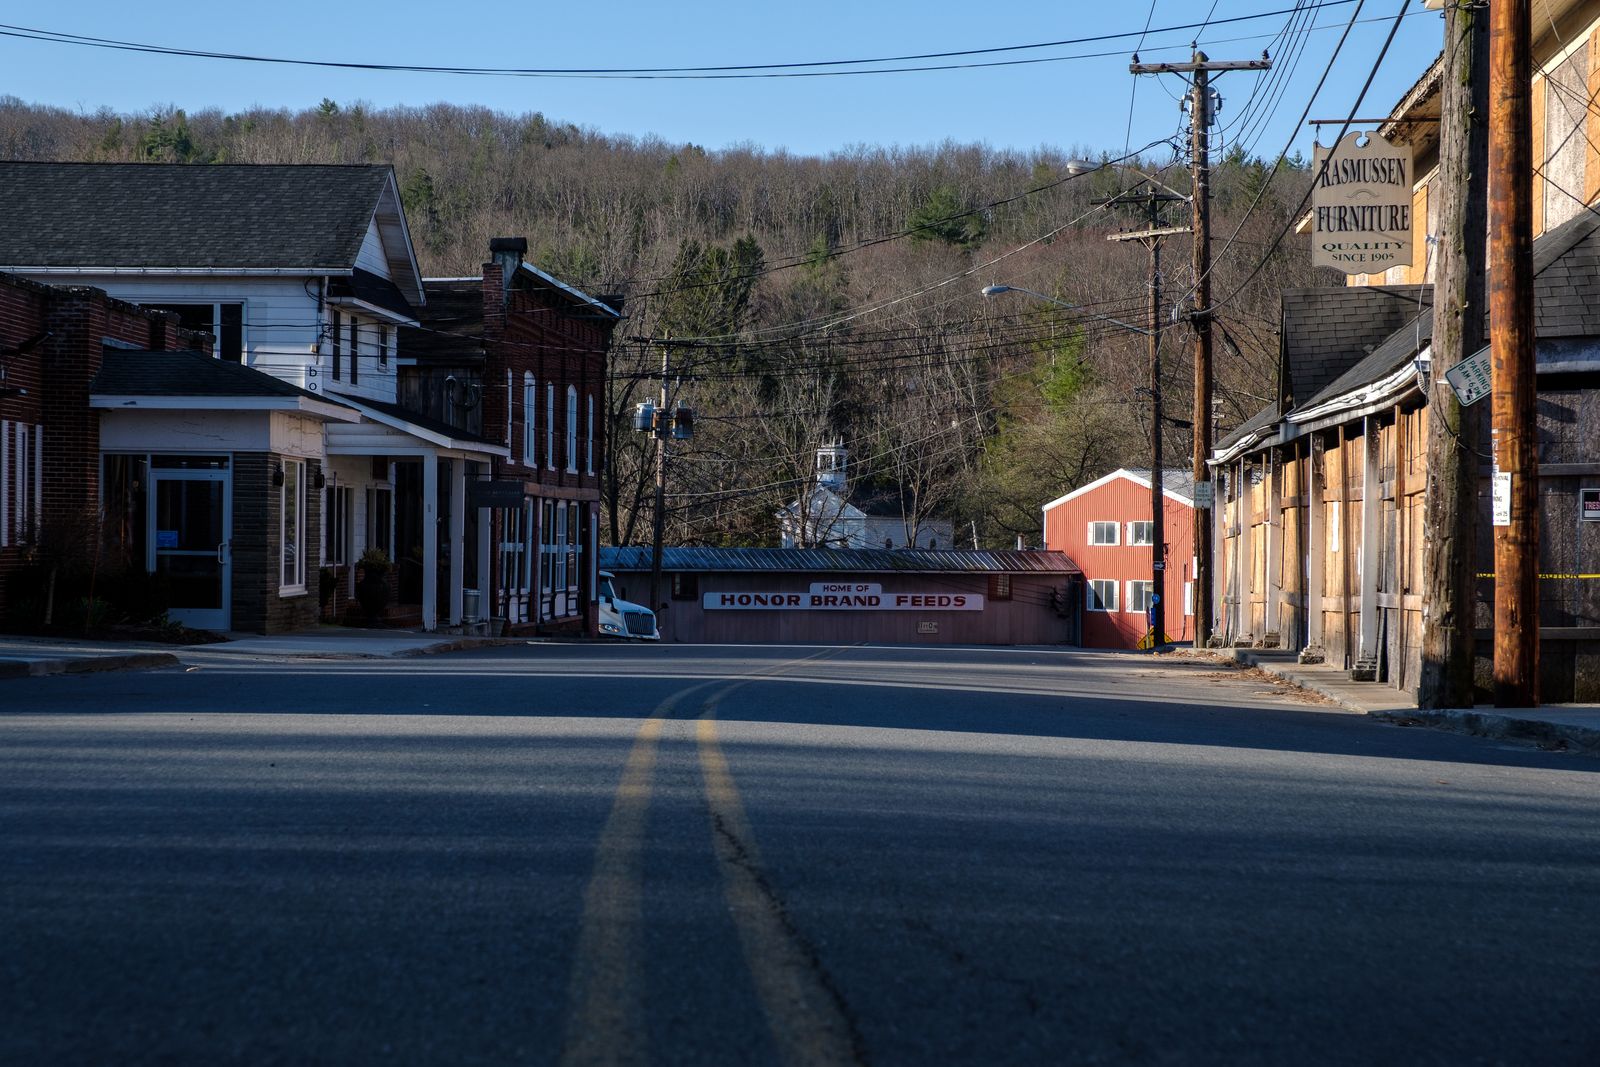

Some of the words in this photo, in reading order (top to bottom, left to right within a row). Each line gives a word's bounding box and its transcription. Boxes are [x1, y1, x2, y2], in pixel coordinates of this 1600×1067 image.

[1320, 157, 1407, 188] RASMUSSEN
[1317, 205, 1409, 232] FURNITURE
[1321, 241, 1406, 252] QUALITY
[1331, 253, 1366, 262] SINCE
[1371, 252, 1395, 262] 1905
[1468, 360, 1490, 390] PARKING
[823, 584, 852, 592] HOME
[855, 584, 870, 592] OF
[720, 594, 801, 606] HONOR
[810, 595, 881, 607] BRAND
[895, 595, 967, 607] FEEDS
